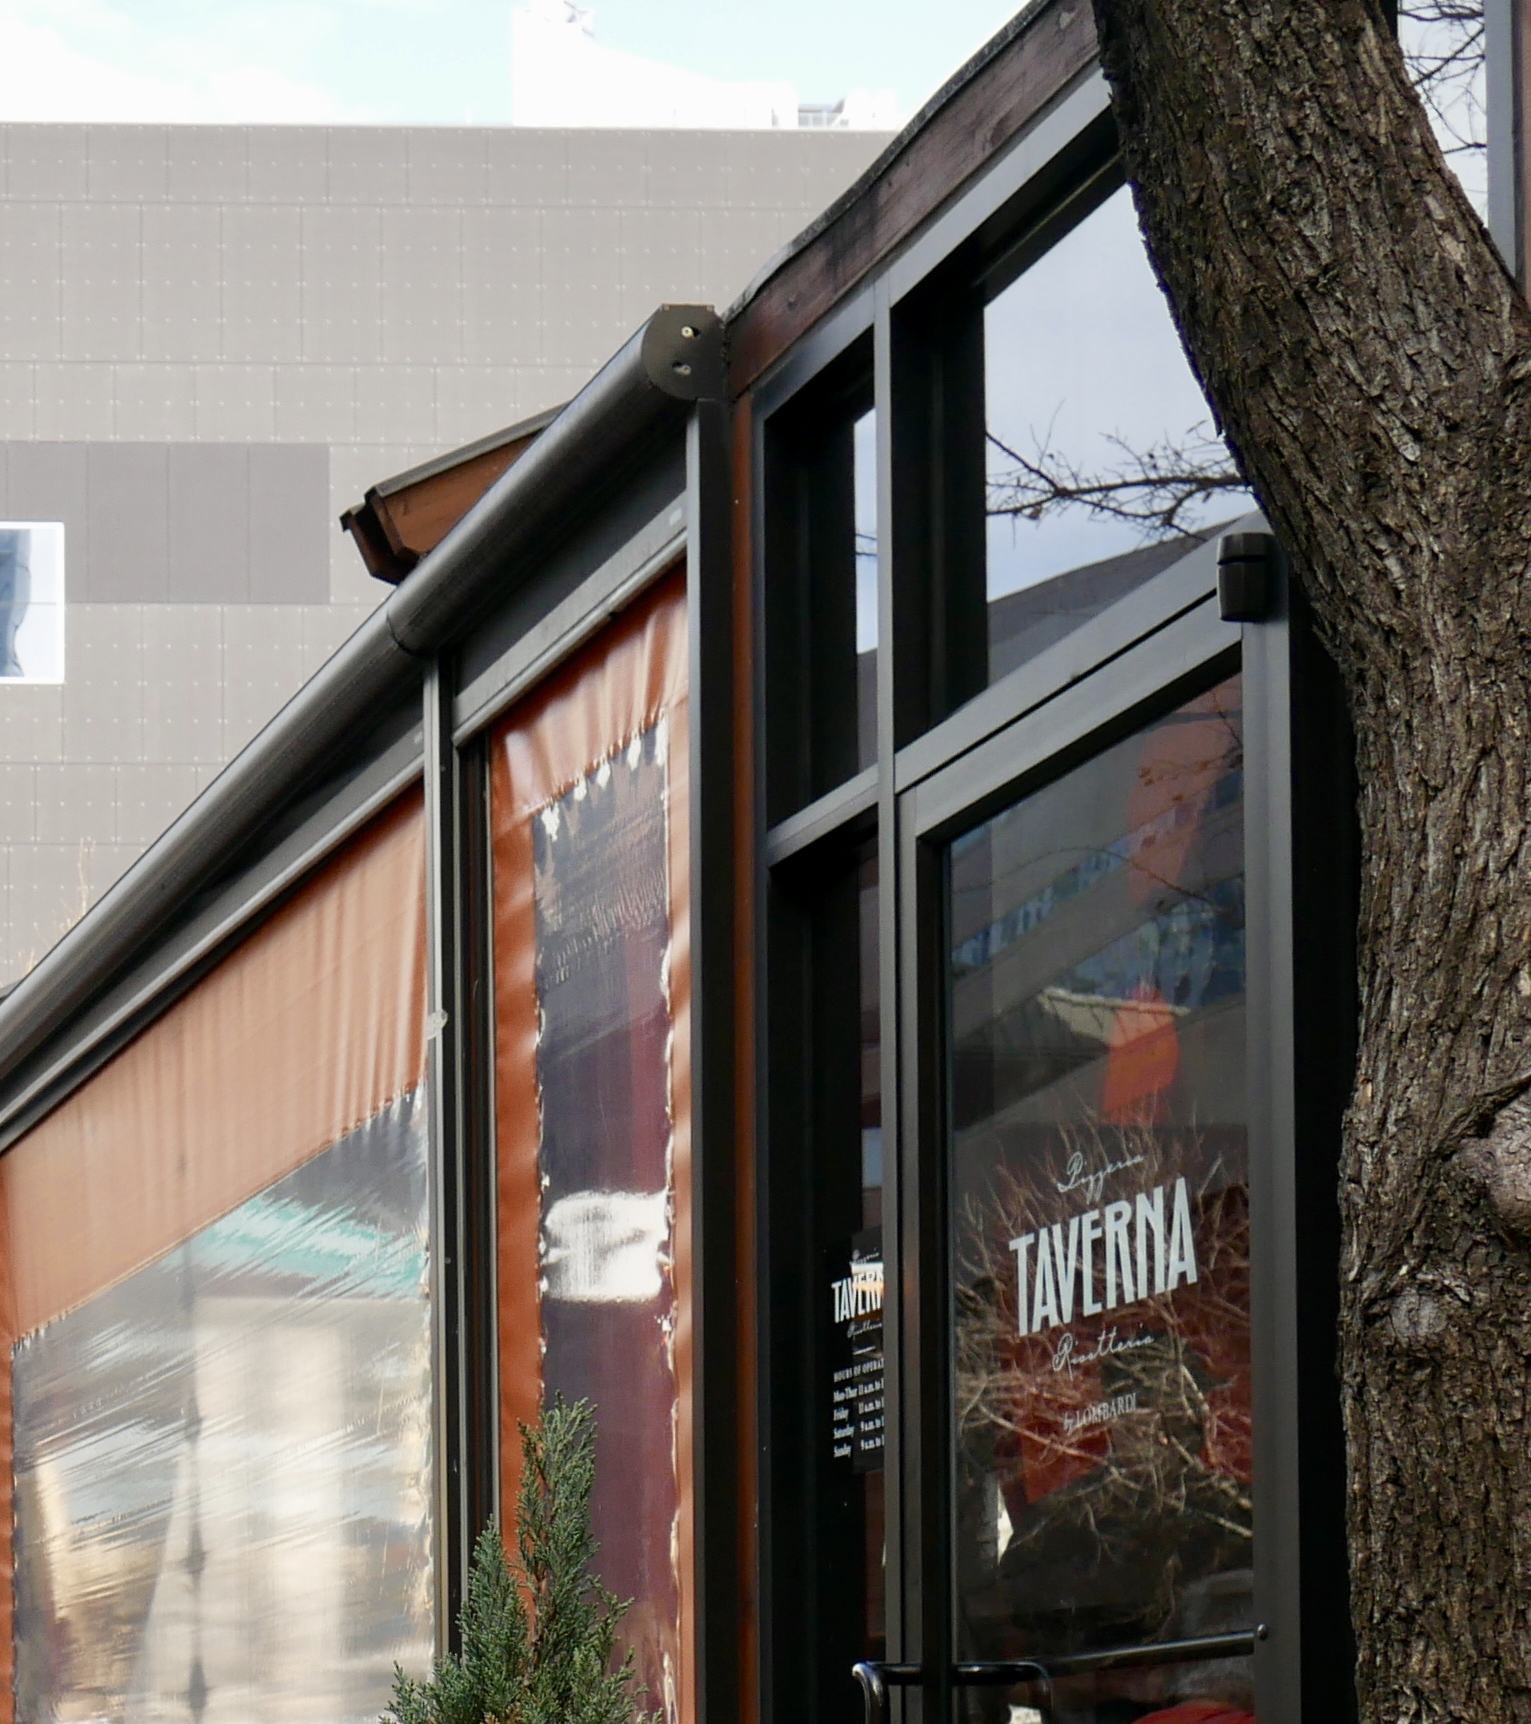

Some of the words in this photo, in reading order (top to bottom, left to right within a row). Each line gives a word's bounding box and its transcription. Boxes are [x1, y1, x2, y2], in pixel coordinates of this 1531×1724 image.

[1057, 1143, 1144, 1204] Pizzeria
[1009, 1176, 1198, 1337] TAVERNA
[831, 1268, 884, 1324] TAVERN
[1052, 1324, 1155, 1381] Risotteria
[1074, 1391, 1137, 1428] LOMBARDI
